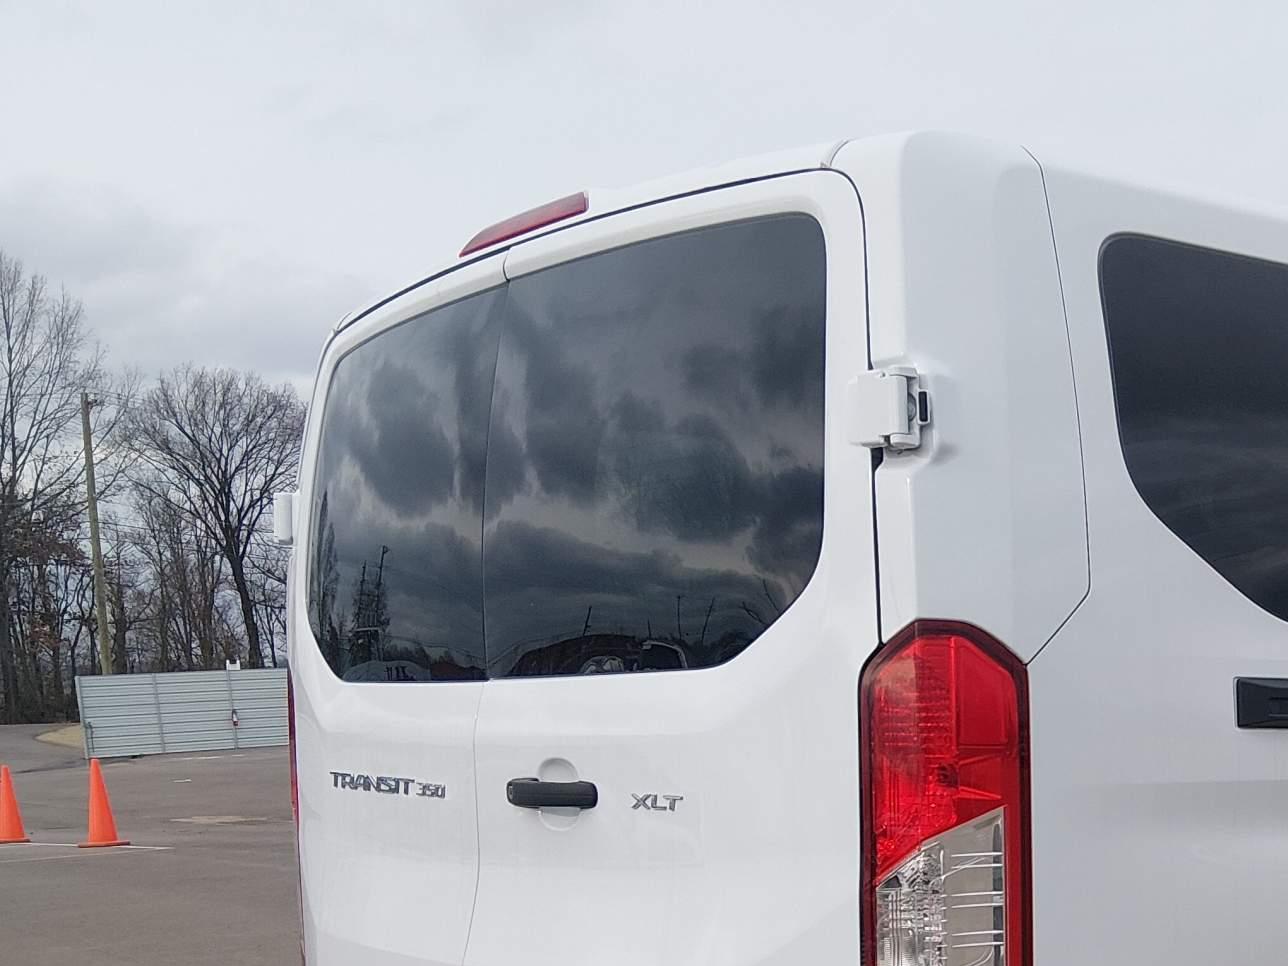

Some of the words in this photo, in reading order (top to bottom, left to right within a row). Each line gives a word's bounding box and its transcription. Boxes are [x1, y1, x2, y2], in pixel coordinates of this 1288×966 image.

[329, 771, 415, 796] TRANSIT
[415, 782, 446, 799] 350
[631, 793, 684, 812] XLT
